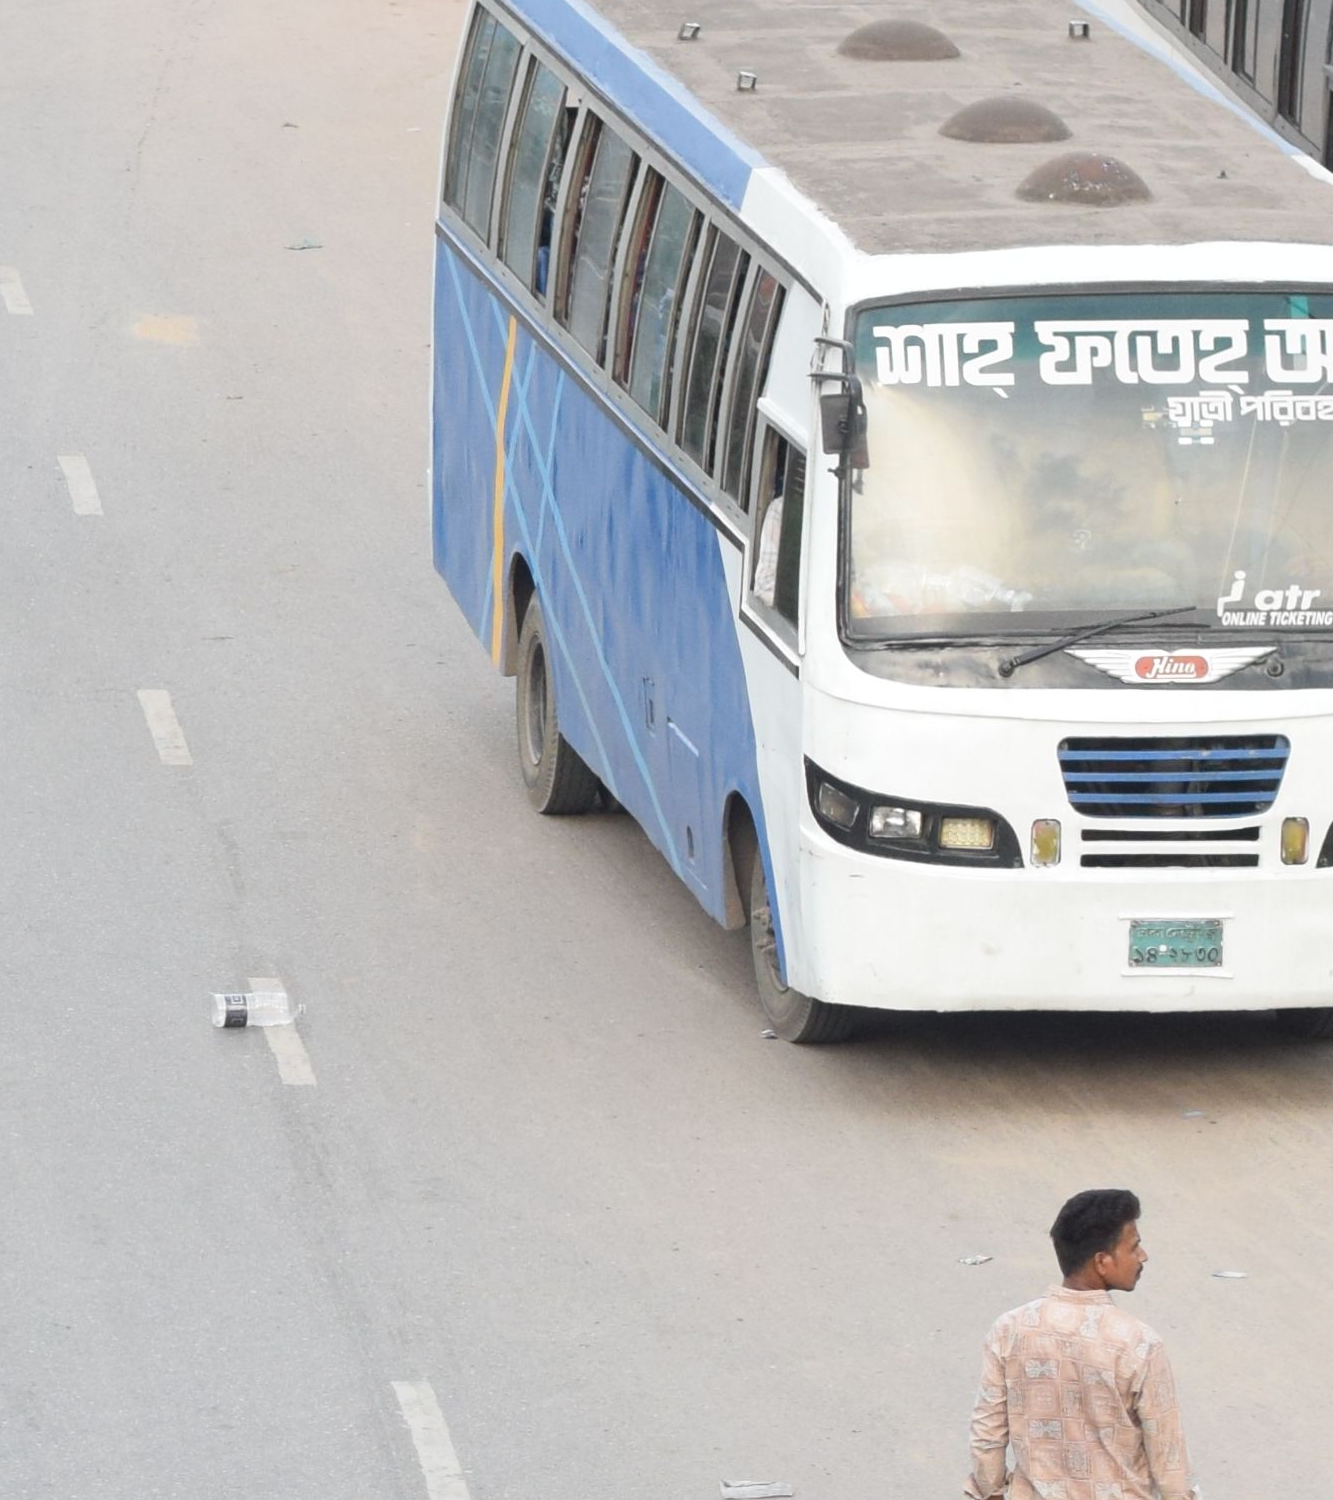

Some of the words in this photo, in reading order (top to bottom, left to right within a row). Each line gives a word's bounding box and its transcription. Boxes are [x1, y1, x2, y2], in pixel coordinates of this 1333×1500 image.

[1221, 611, 1266, 627] ONLINE
[1268, 610, 1333, 626] TICKETING
[1145, 655, 1197, 679] Hino
